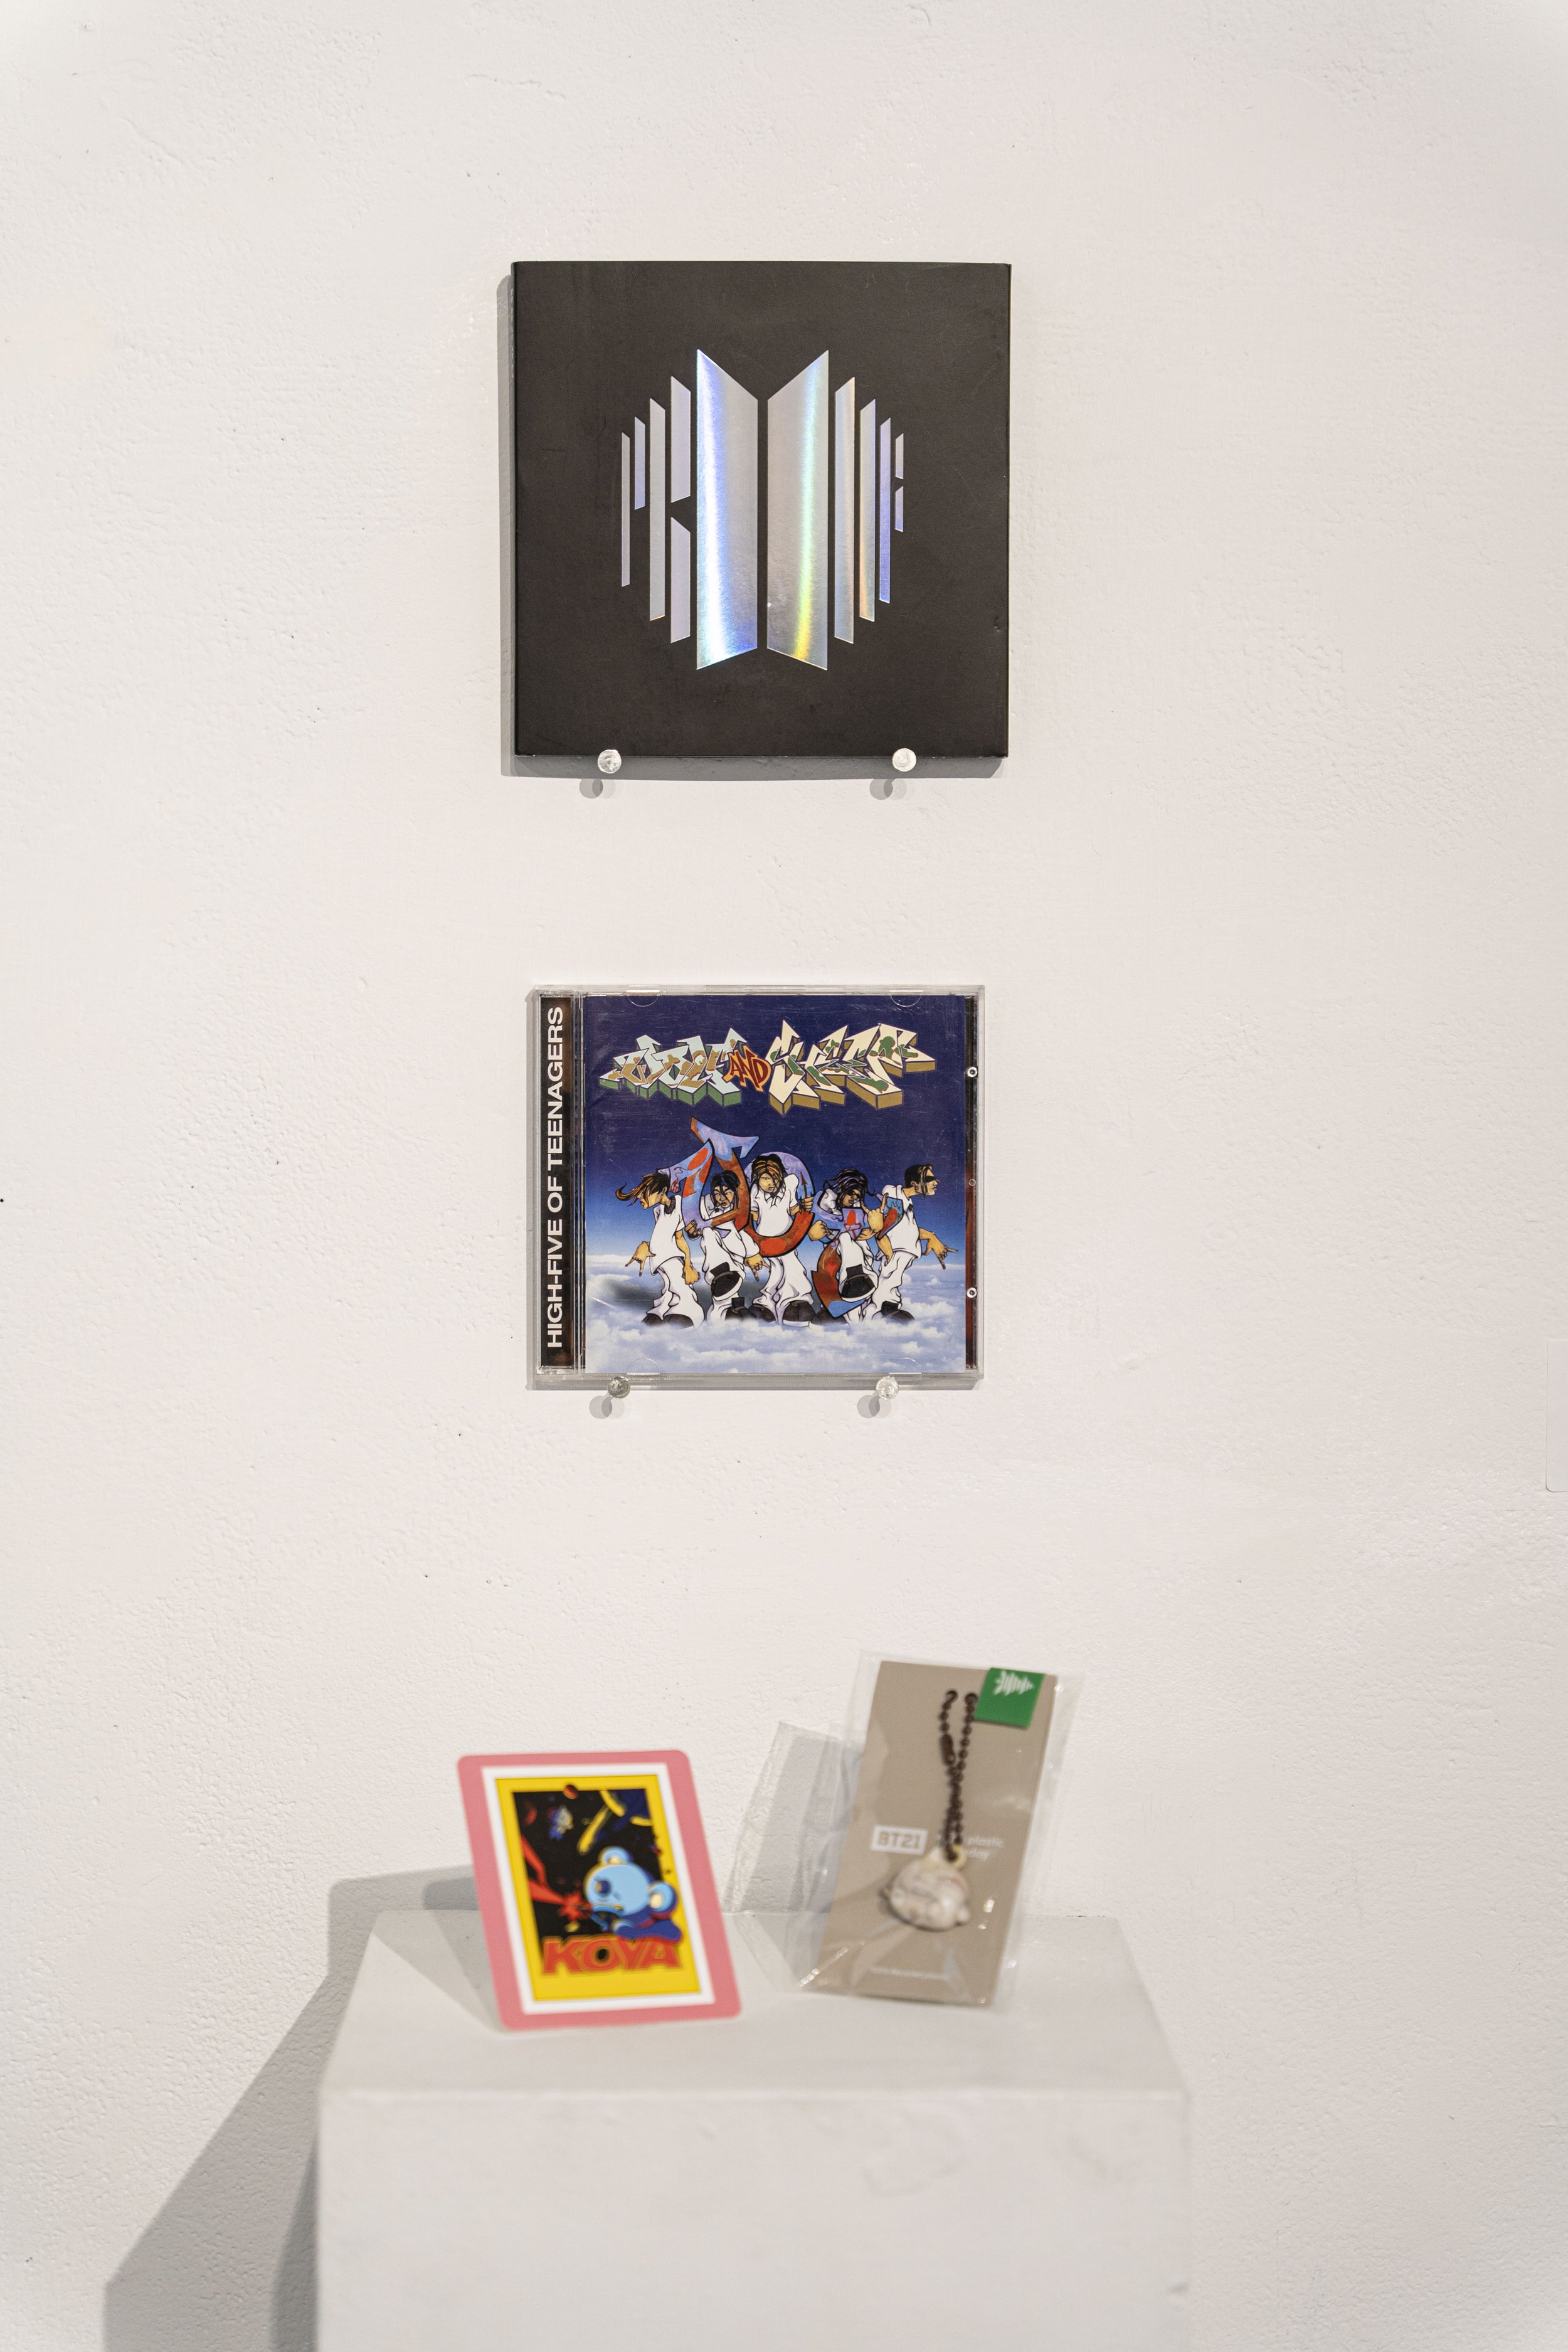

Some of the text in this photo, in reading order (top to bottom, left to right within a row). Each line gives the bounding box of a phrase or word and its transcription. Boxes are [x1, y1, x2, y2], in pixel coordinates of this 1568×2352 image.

[721, 1045, 771, 1093] AND
[547, 1006, 564, 1348] HIGH-FIVE OF TEENAGERS
[876, 1829, 924, 1851] BT21
[542, 1934, 682, 1977] KOYA
